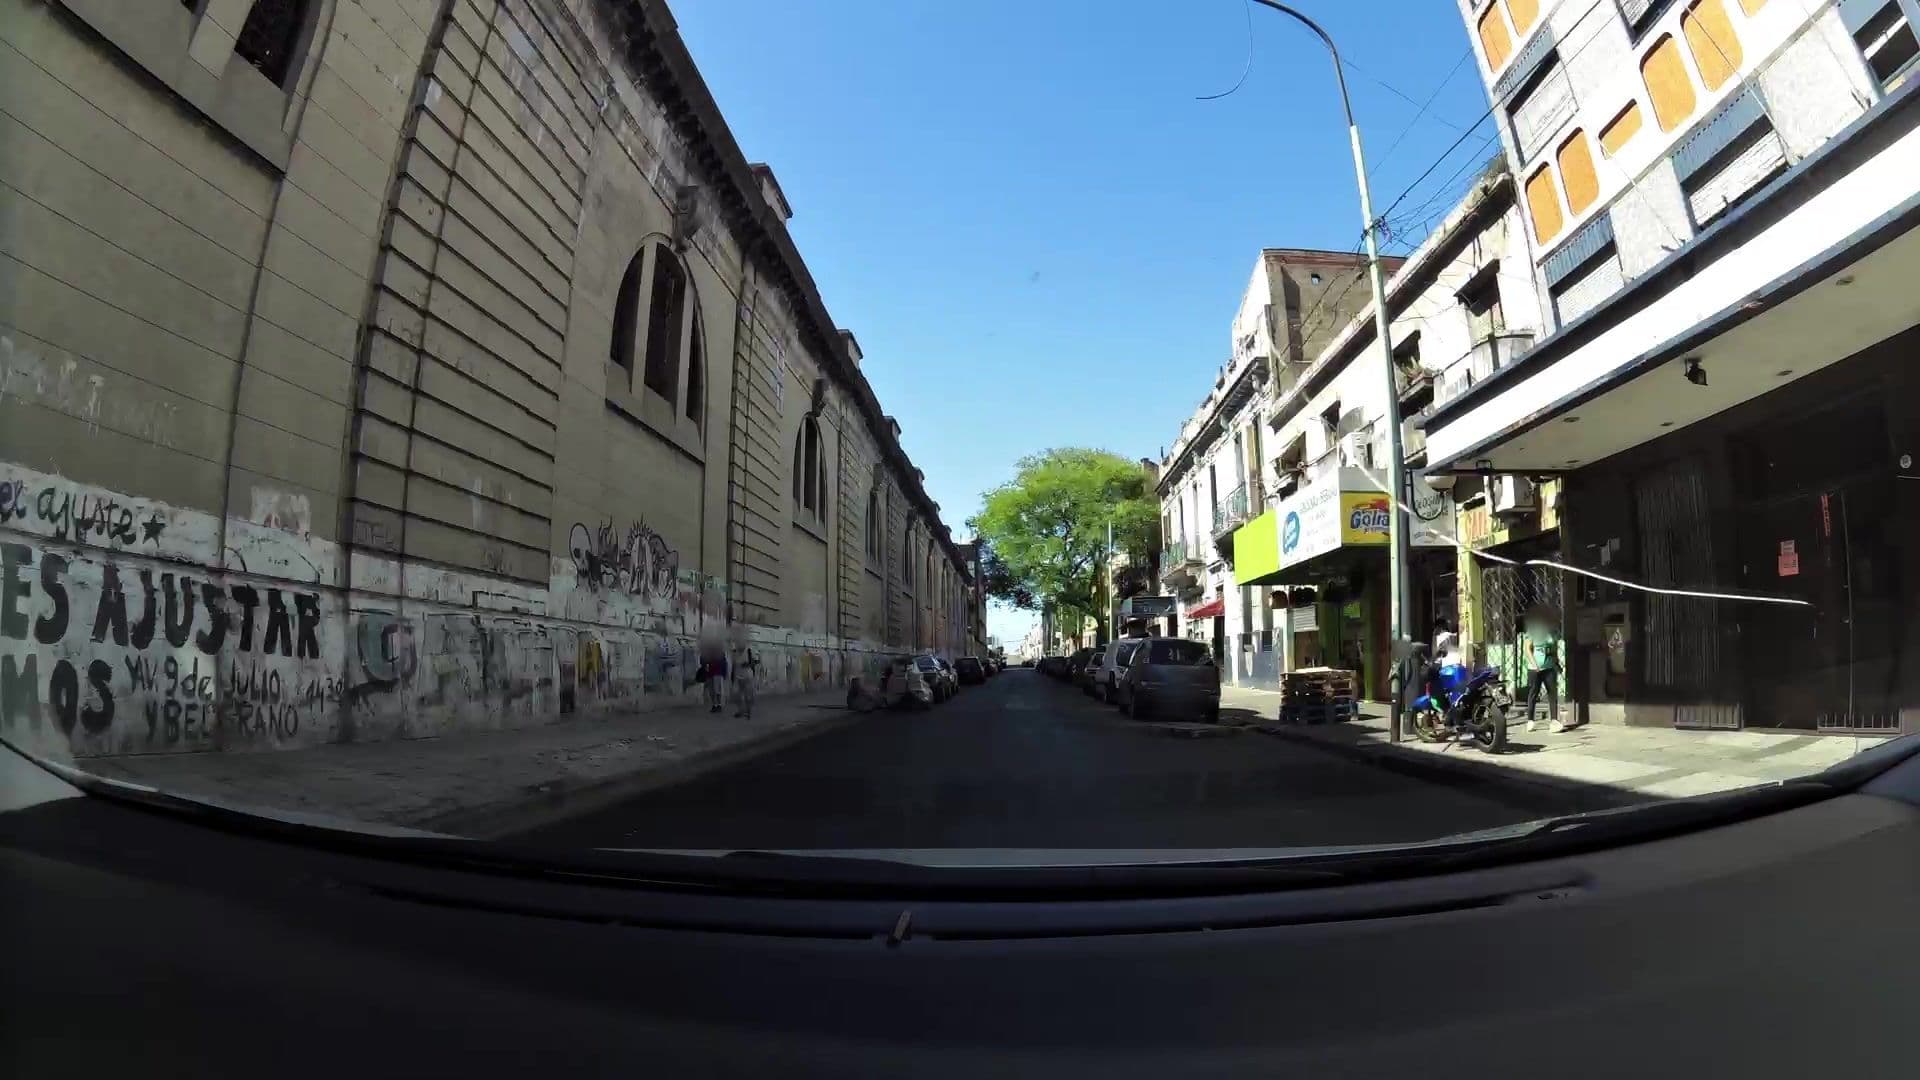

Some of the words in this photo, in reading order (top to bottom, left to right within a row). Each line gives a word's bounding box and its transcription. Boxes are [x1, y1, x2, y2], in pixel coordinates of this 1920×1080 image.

[37, 486, 137, 545] ajuste
[89, 562, 321, 660] AJUSTAR
[0, 653, 116, 738] MOS
[180, 656, 213, 701] de
[223, 657, 281, 704] JULIO
[163, 699, 299, 743] BELRANO
